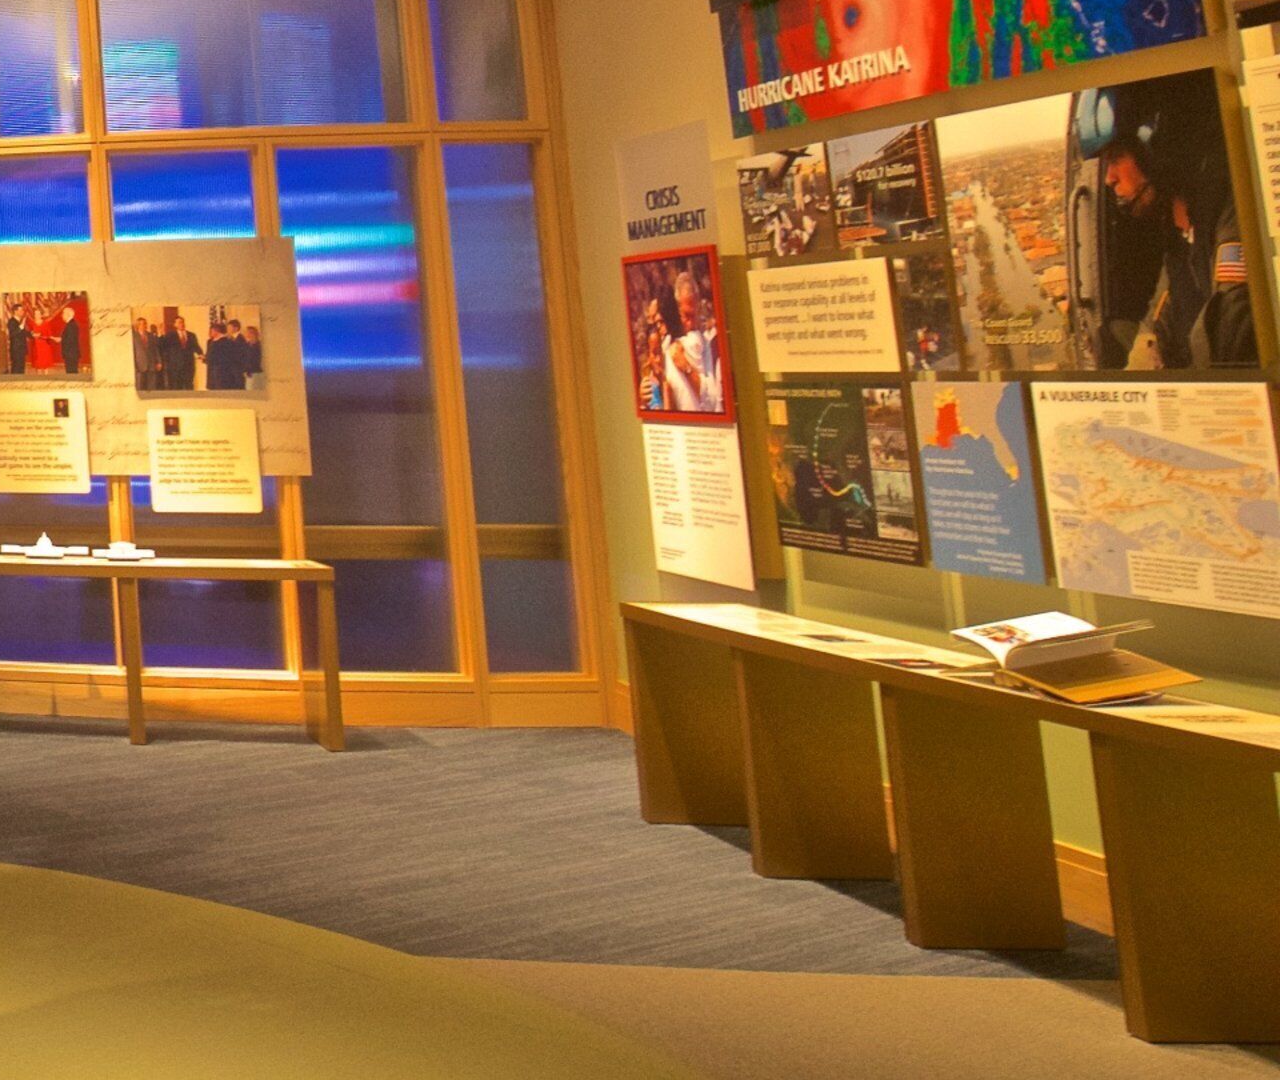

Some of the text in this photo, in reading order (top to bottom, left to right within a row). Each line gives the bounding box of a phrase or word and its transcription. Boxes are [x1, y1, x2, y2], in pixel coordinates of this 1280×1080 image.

[737, 44, 911, 112] HURRICANE KATRINA
[645, 185, 681, 211] CRISIS
[627, 209, 707, 241] MANAGEMENT
[1040, 391, 1148, 404] A VULNERABLE CITY
